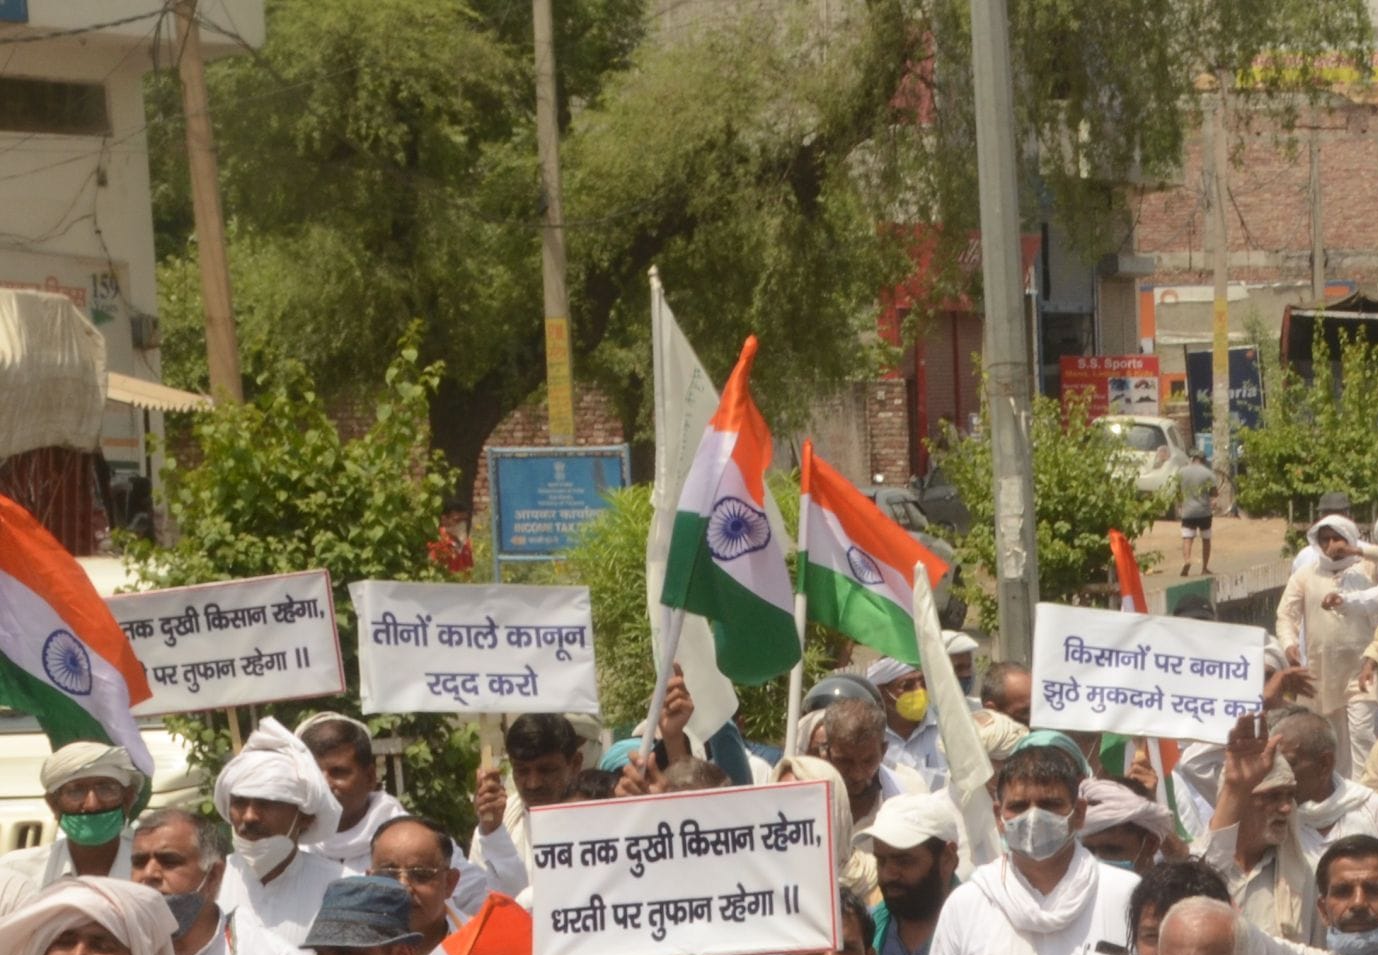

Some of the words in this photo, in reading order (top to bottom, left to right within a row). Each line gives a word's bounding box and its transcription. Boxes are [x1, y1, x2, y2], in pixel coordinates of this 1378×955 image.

[1078, 359, 1100, 369] S.S.
[1104, 358, 1143, 370] Sports
[159, 606, 200, 647] दुखी
[204, 603, 267, 633] किसान
[271, 594, 325, 624] रहेगा,
[371, 610, 433, 648] तीनों
[436, 616, 500, 650] काले
[505, 624, 587, 661] कानून
[153, 664, 178, 686] पर
[182, 656, 236, 692] तुफान
[240, 647, 288, 677] रहेगा
[486, 664, 538, 697] करो
[1063, 635, 1151, 671] किसानों
[1154, 652, 1185, 675] पर
[1189, 655, 1251, 681] बनाये
[1042, 676, 1082, 711] झुठे
[1086, 685, 1165, 714] मुकदमे
[533, 842, 574, 870] जब
[579, 837, 619, 867] तक
[625, 821, 674, 878] दुखी
[679, 818, 755, 859] किसान
[760, 810, 822, 852] रहेगा,
[551, 894, 605, 934] धरती
[612, 902, 643, 929] पर
[648, 896, 713, 941] तुफान
[718, 882, 774, 922] रहेगा
